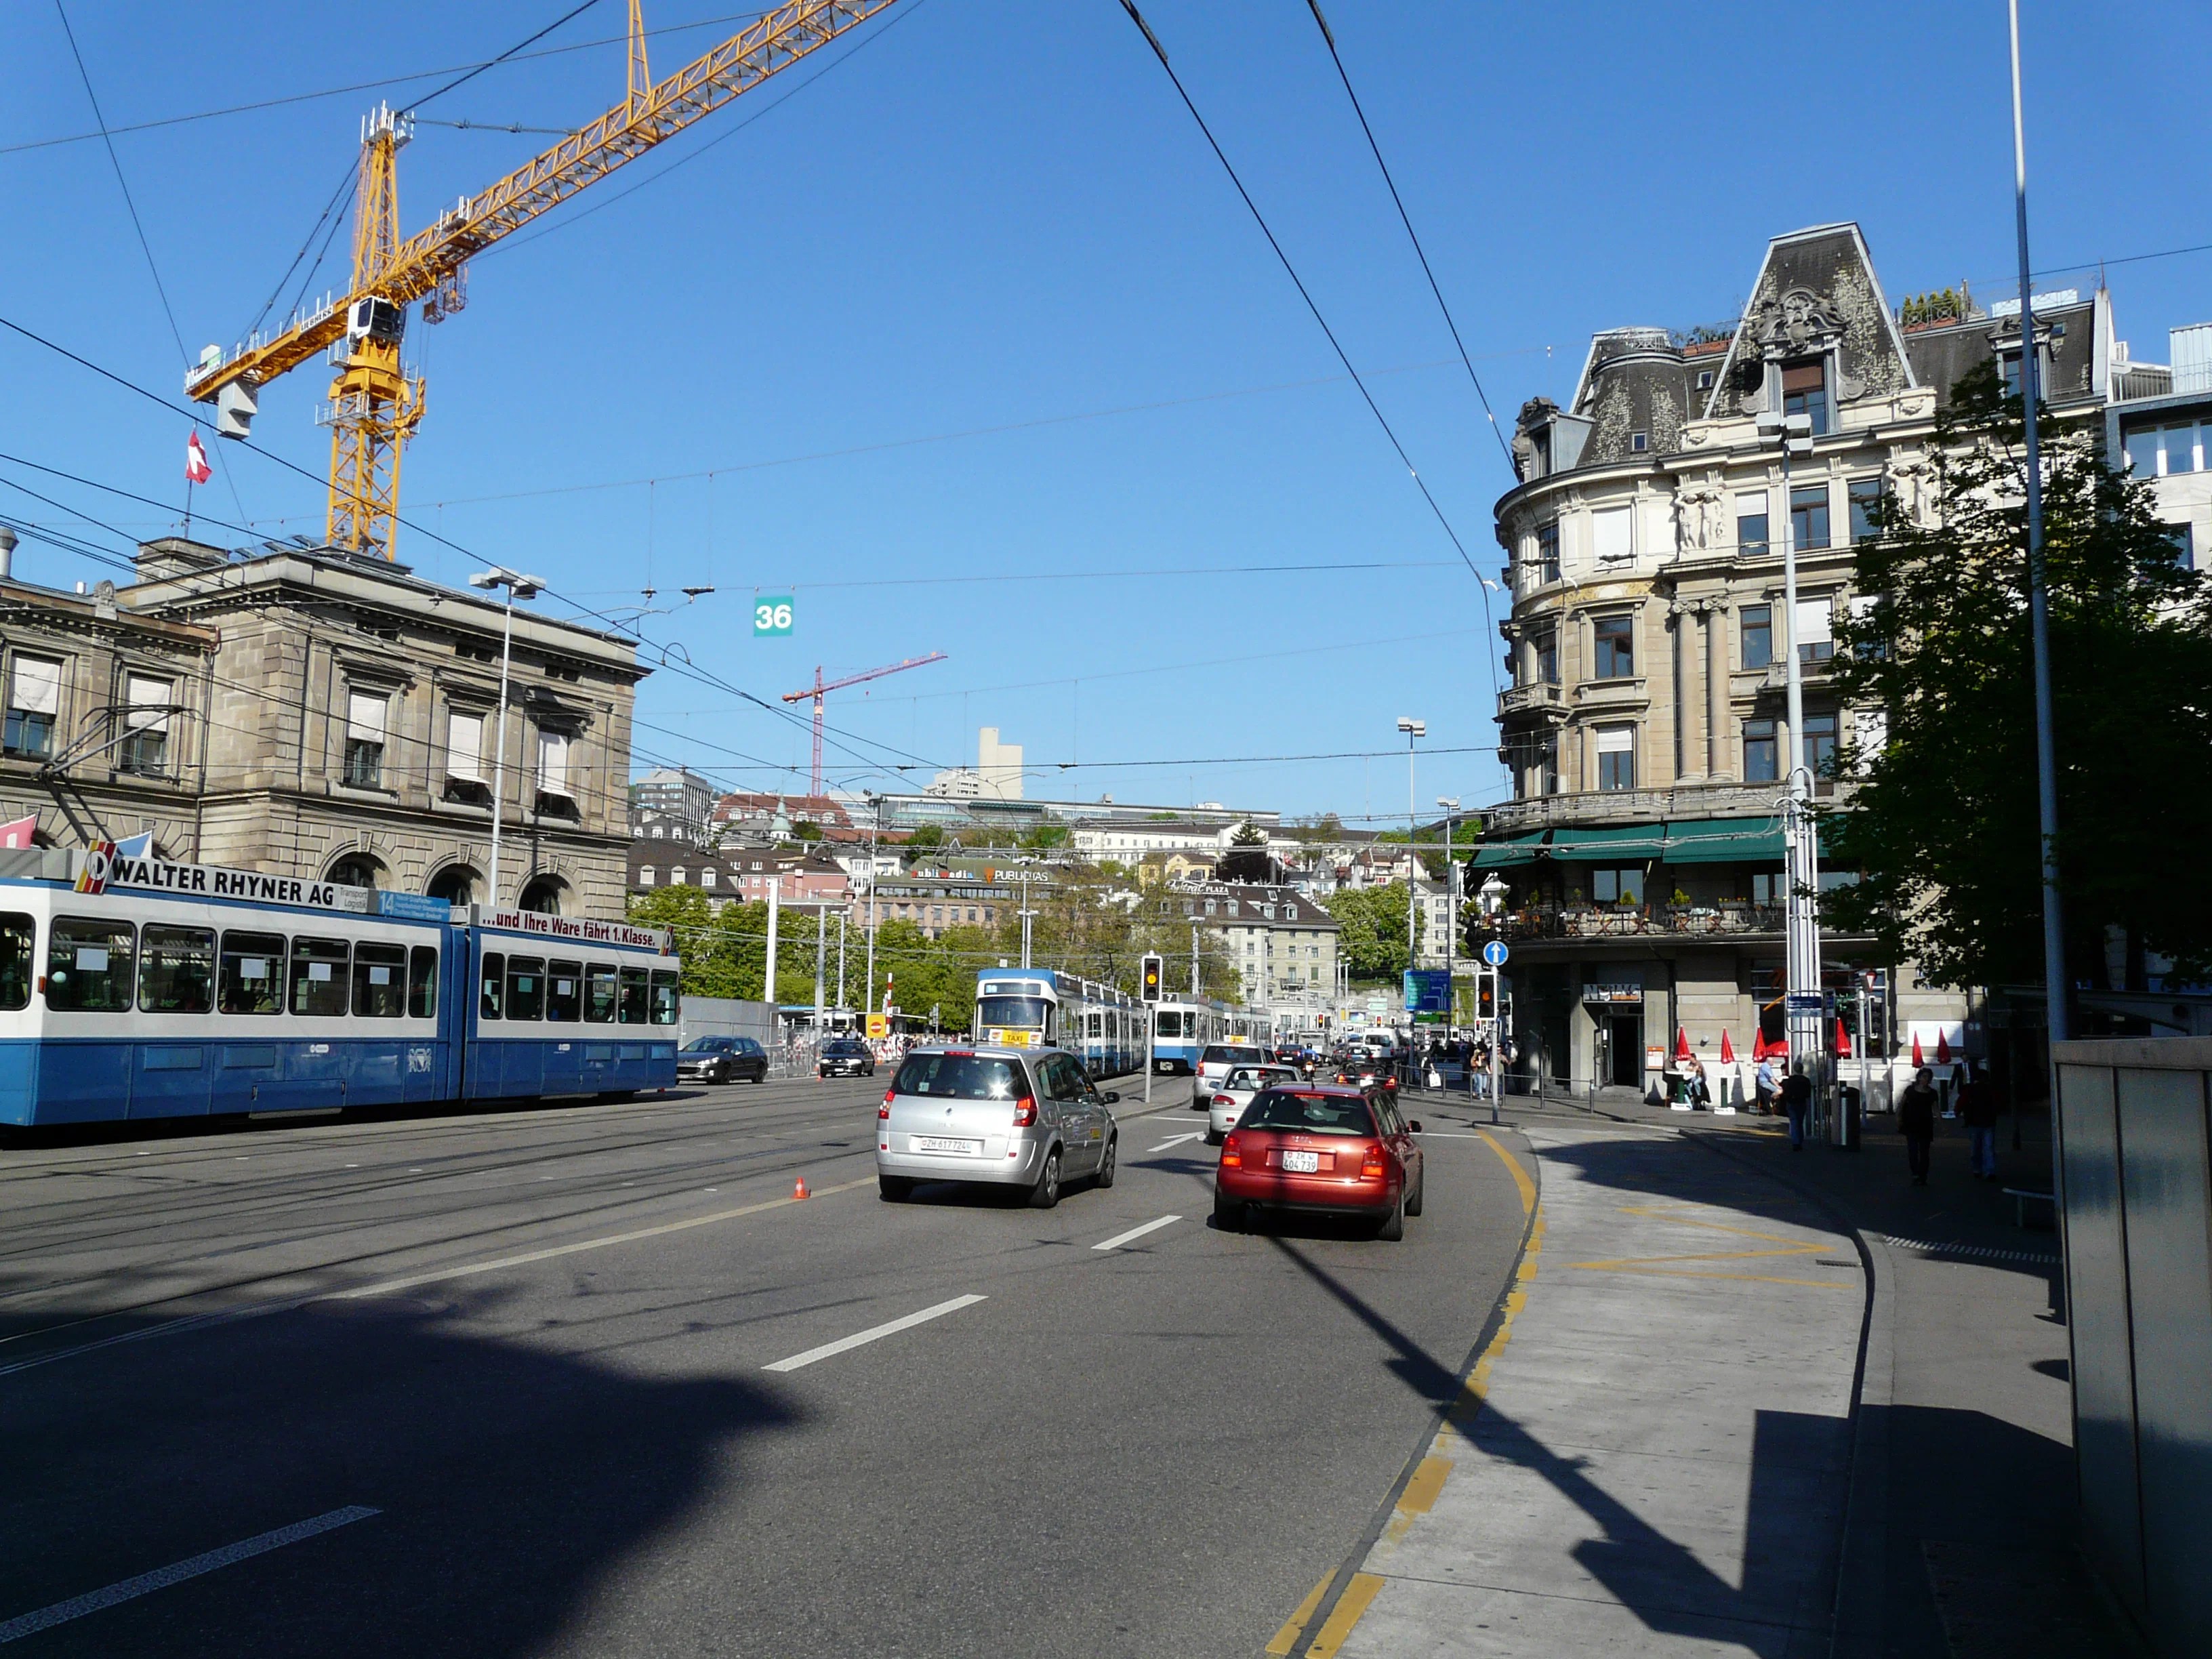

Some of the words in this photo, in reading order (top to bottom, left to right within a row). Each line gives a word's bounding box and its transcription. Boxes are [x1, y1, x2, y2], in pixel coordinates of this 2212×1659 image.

[755, 604, 792, 629] 36
[112, 858, 206, 891] WALTER
[214, 872, 302, 902] RHYNER
[308, 884, 334, 905] AG
[340, 887, 368, 899] Transport
[344, 897, 366, 909] Logistik
[380, 893, 394, 915] 14
[524, 913, 548, 932] Ihre
[552, 918, 580, 936] Ware
[583, 922, 610, 940] fährt
[1166, 994, 1173, 1002] 7
